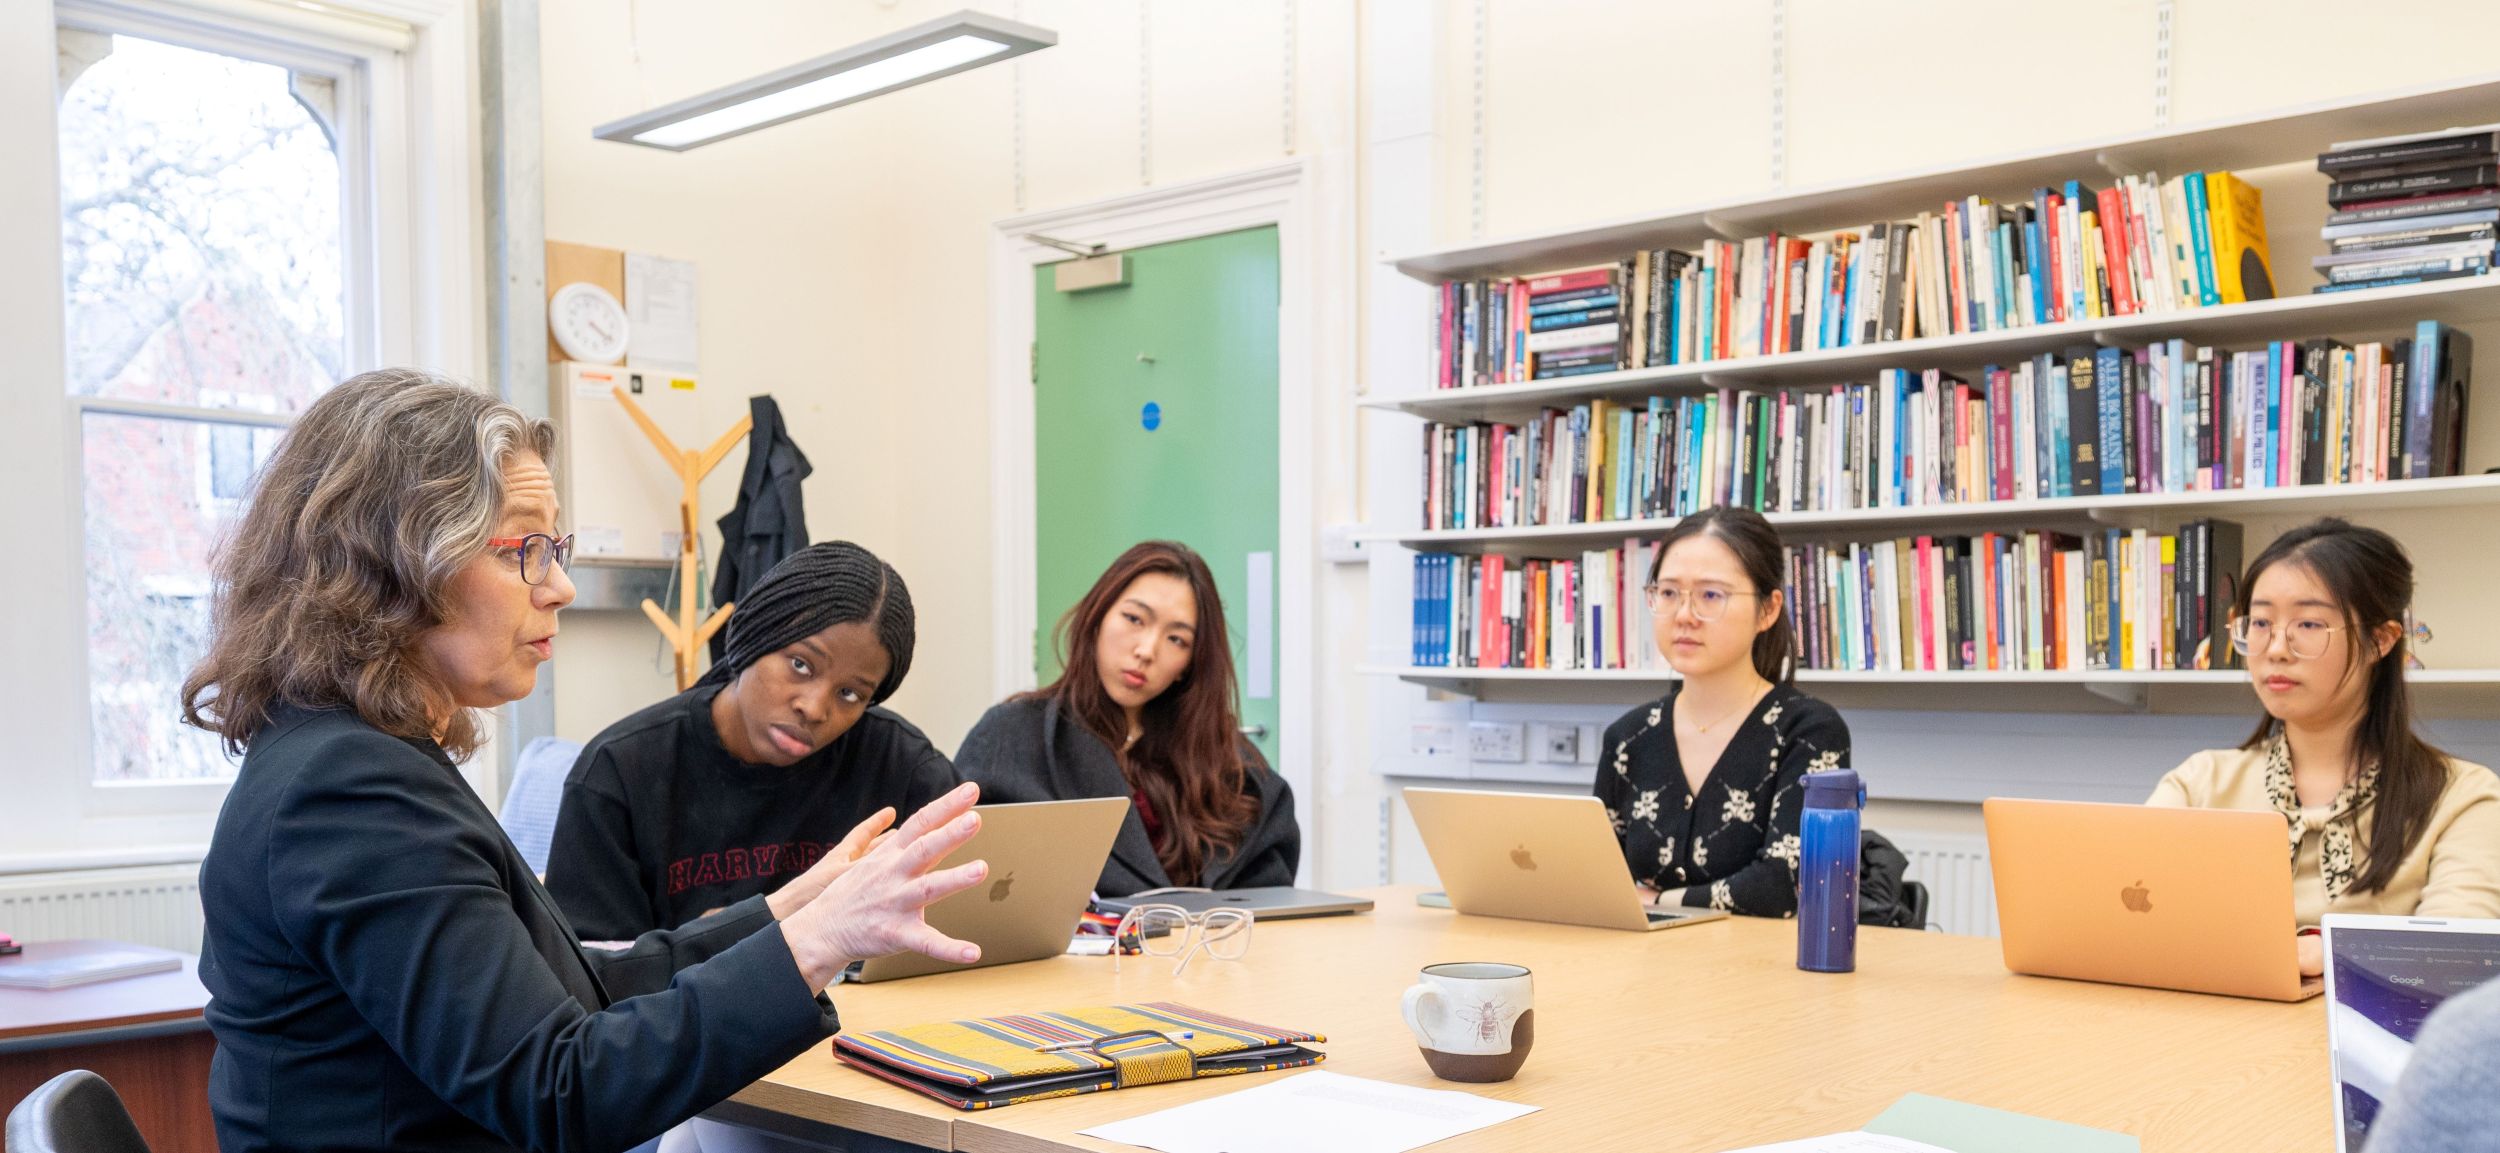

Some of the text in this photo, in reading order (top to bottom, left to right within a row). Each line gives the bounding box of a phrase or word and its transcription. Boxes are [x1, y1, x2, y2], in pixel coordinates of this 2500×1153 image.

[2352, 183, 2367, 194] City
[2376, 207, 2389, 216] NEW
[2392, 203, 2426, 214] AMERICAN
[2255, 364, 2265, 386] WHEN
[2098, 366, 2106, 413] COUNTRY
[2254, 388, 2265, 412] PEACE
[2105, 357, 2122, 469] ALEX BORAINE
[2252, 437, 2263, 469] POLITICS
[669, 843, 836, 894] HARVAR
[2389, 974, 2425, 986] Google
